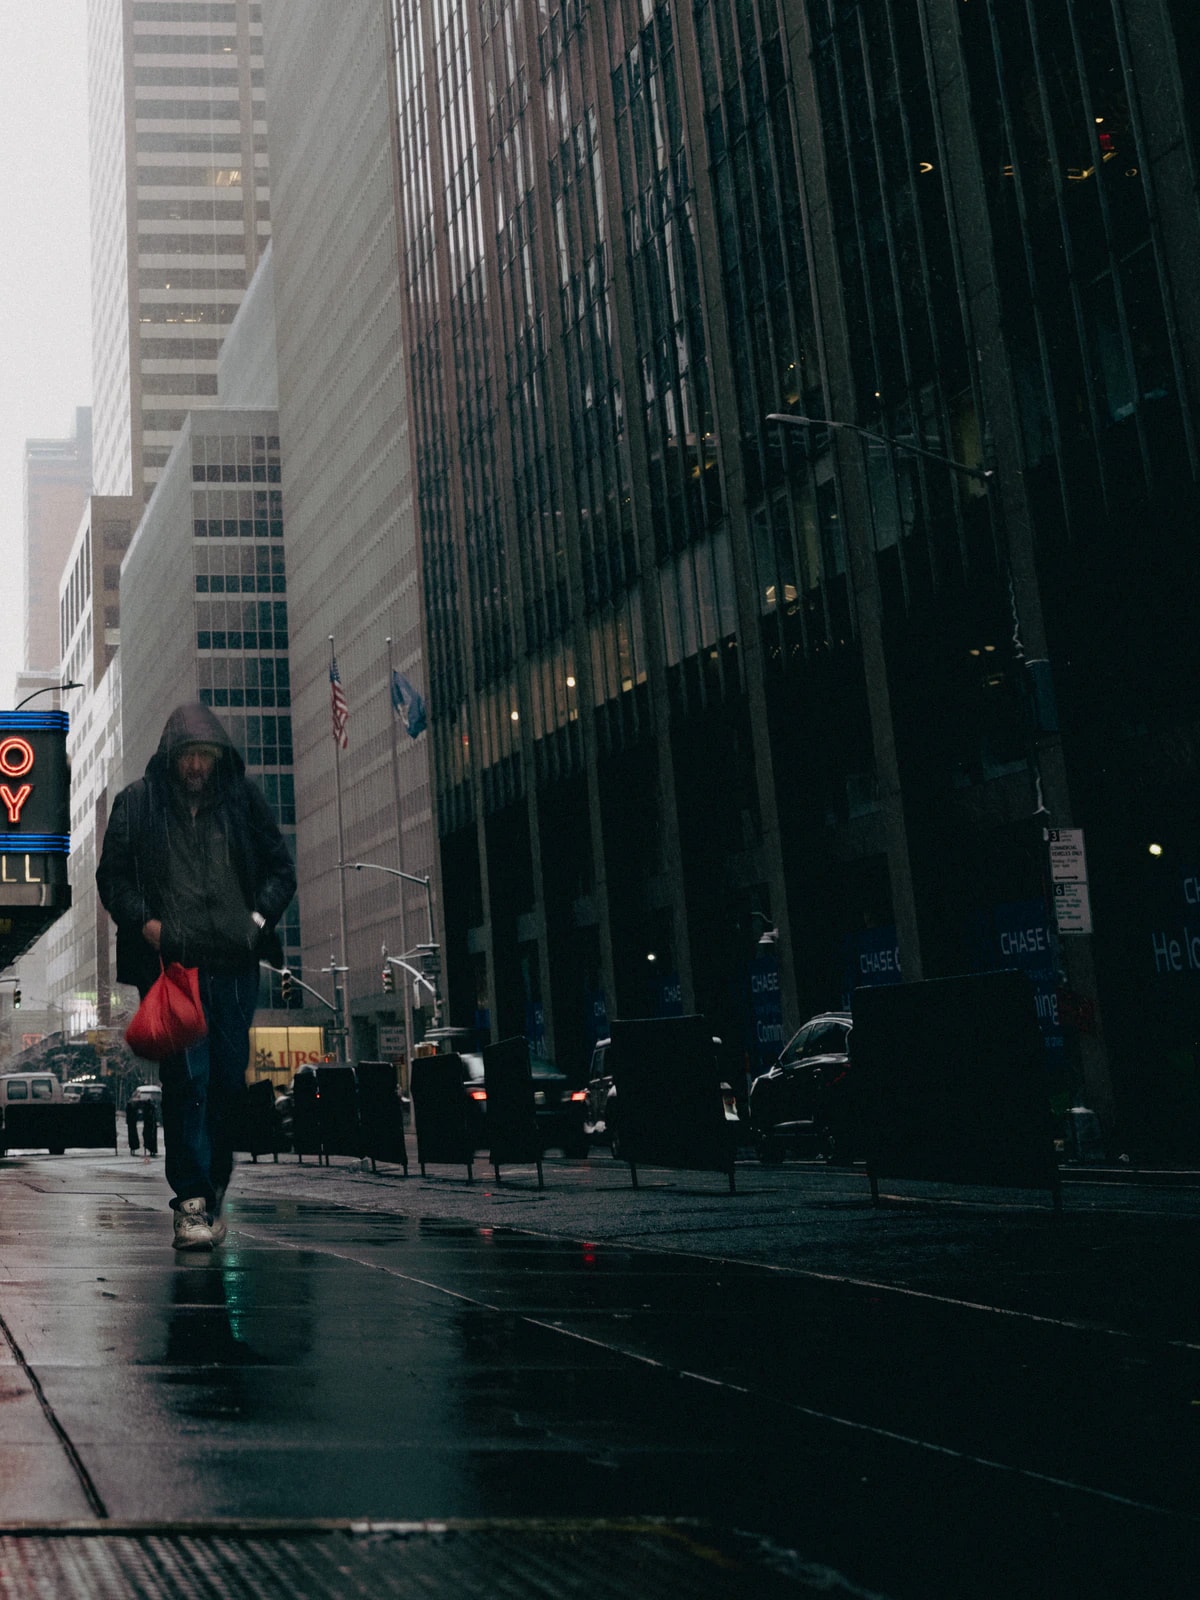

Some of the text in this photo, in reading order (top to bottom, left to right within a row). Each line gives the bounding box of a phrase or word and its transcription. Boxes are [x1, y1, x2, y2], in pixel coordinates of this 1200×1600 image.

[1000, 927, 1047, 956] CHASE
[859, 949, 894, 974] CHASE
[278, 1050, 320, 1069] UBS
